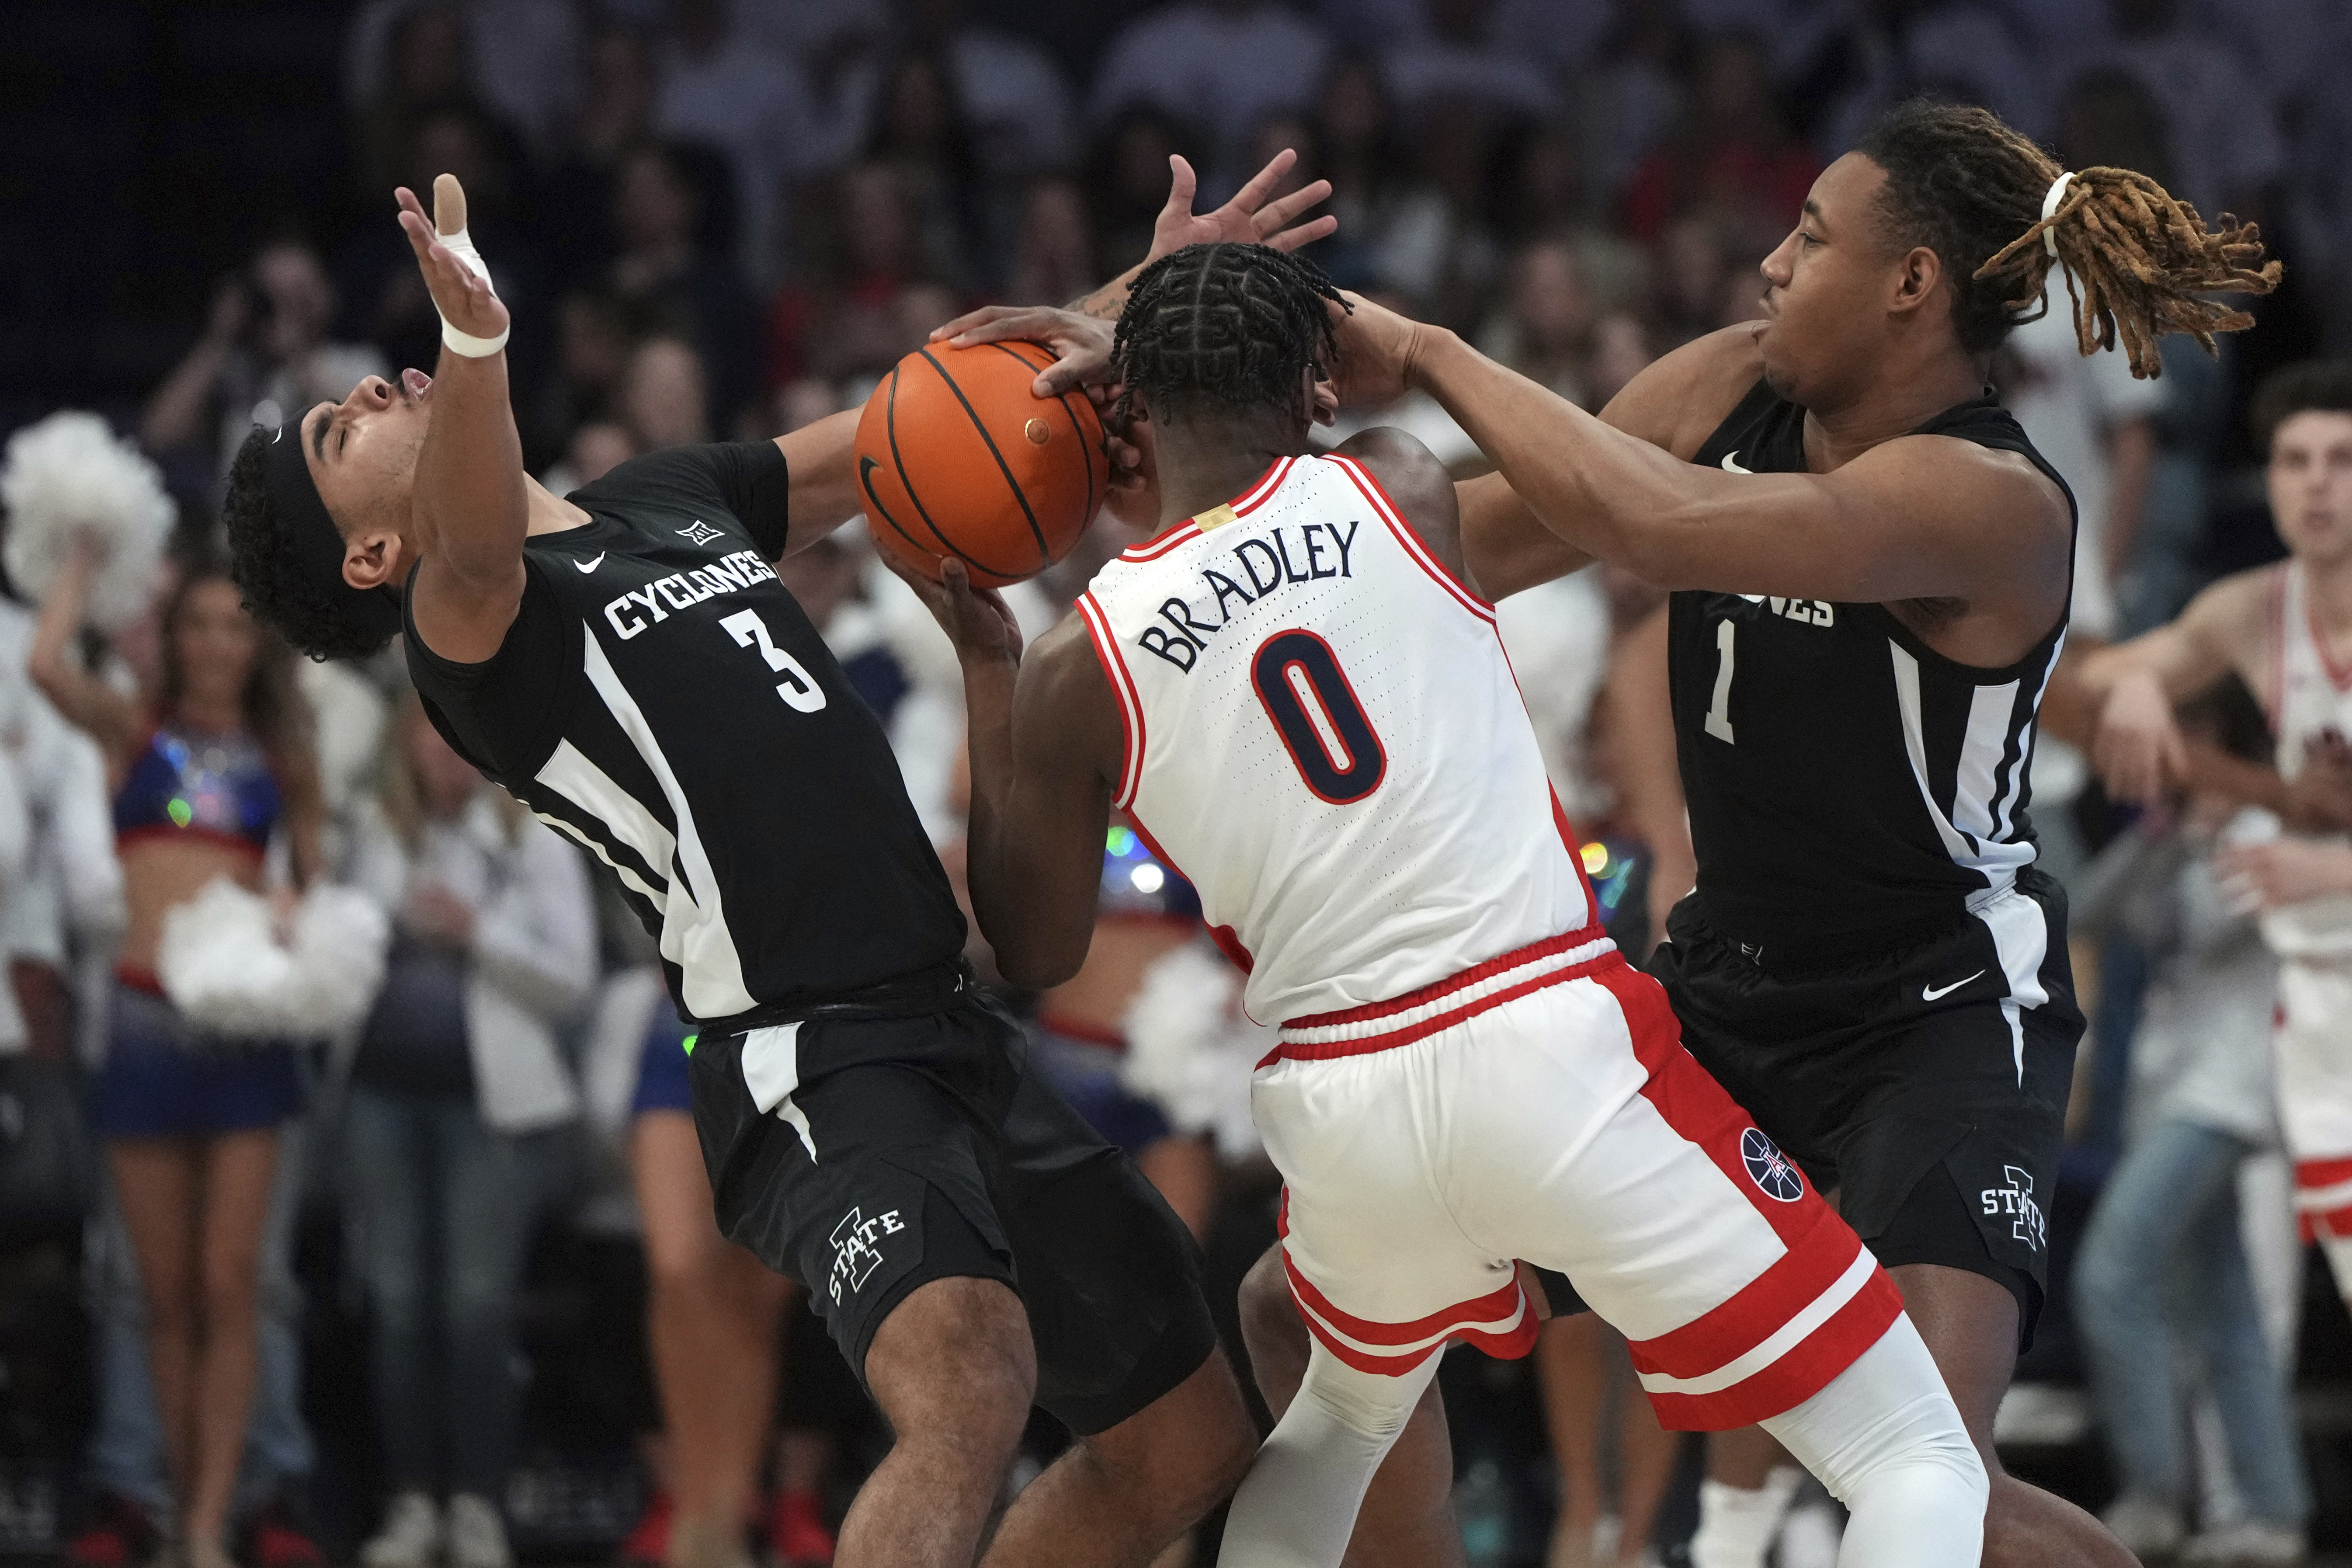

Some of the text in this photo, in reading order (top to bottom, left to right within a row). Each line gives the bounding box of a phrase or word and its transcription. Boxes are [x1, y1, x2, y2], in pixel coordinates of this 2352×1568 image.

[604, 550, 777, 640] CYCLONES
[1138, 521, 1359, 674] BRADLEY
[718, 608, 827, 713] 3
[1704, 619, 1735, 745] 1
[1250, 628, 1387, 805] 0
[829, 1209, 905, 1307] STATE
[1981, 1189, 2046, 1248] STATE
